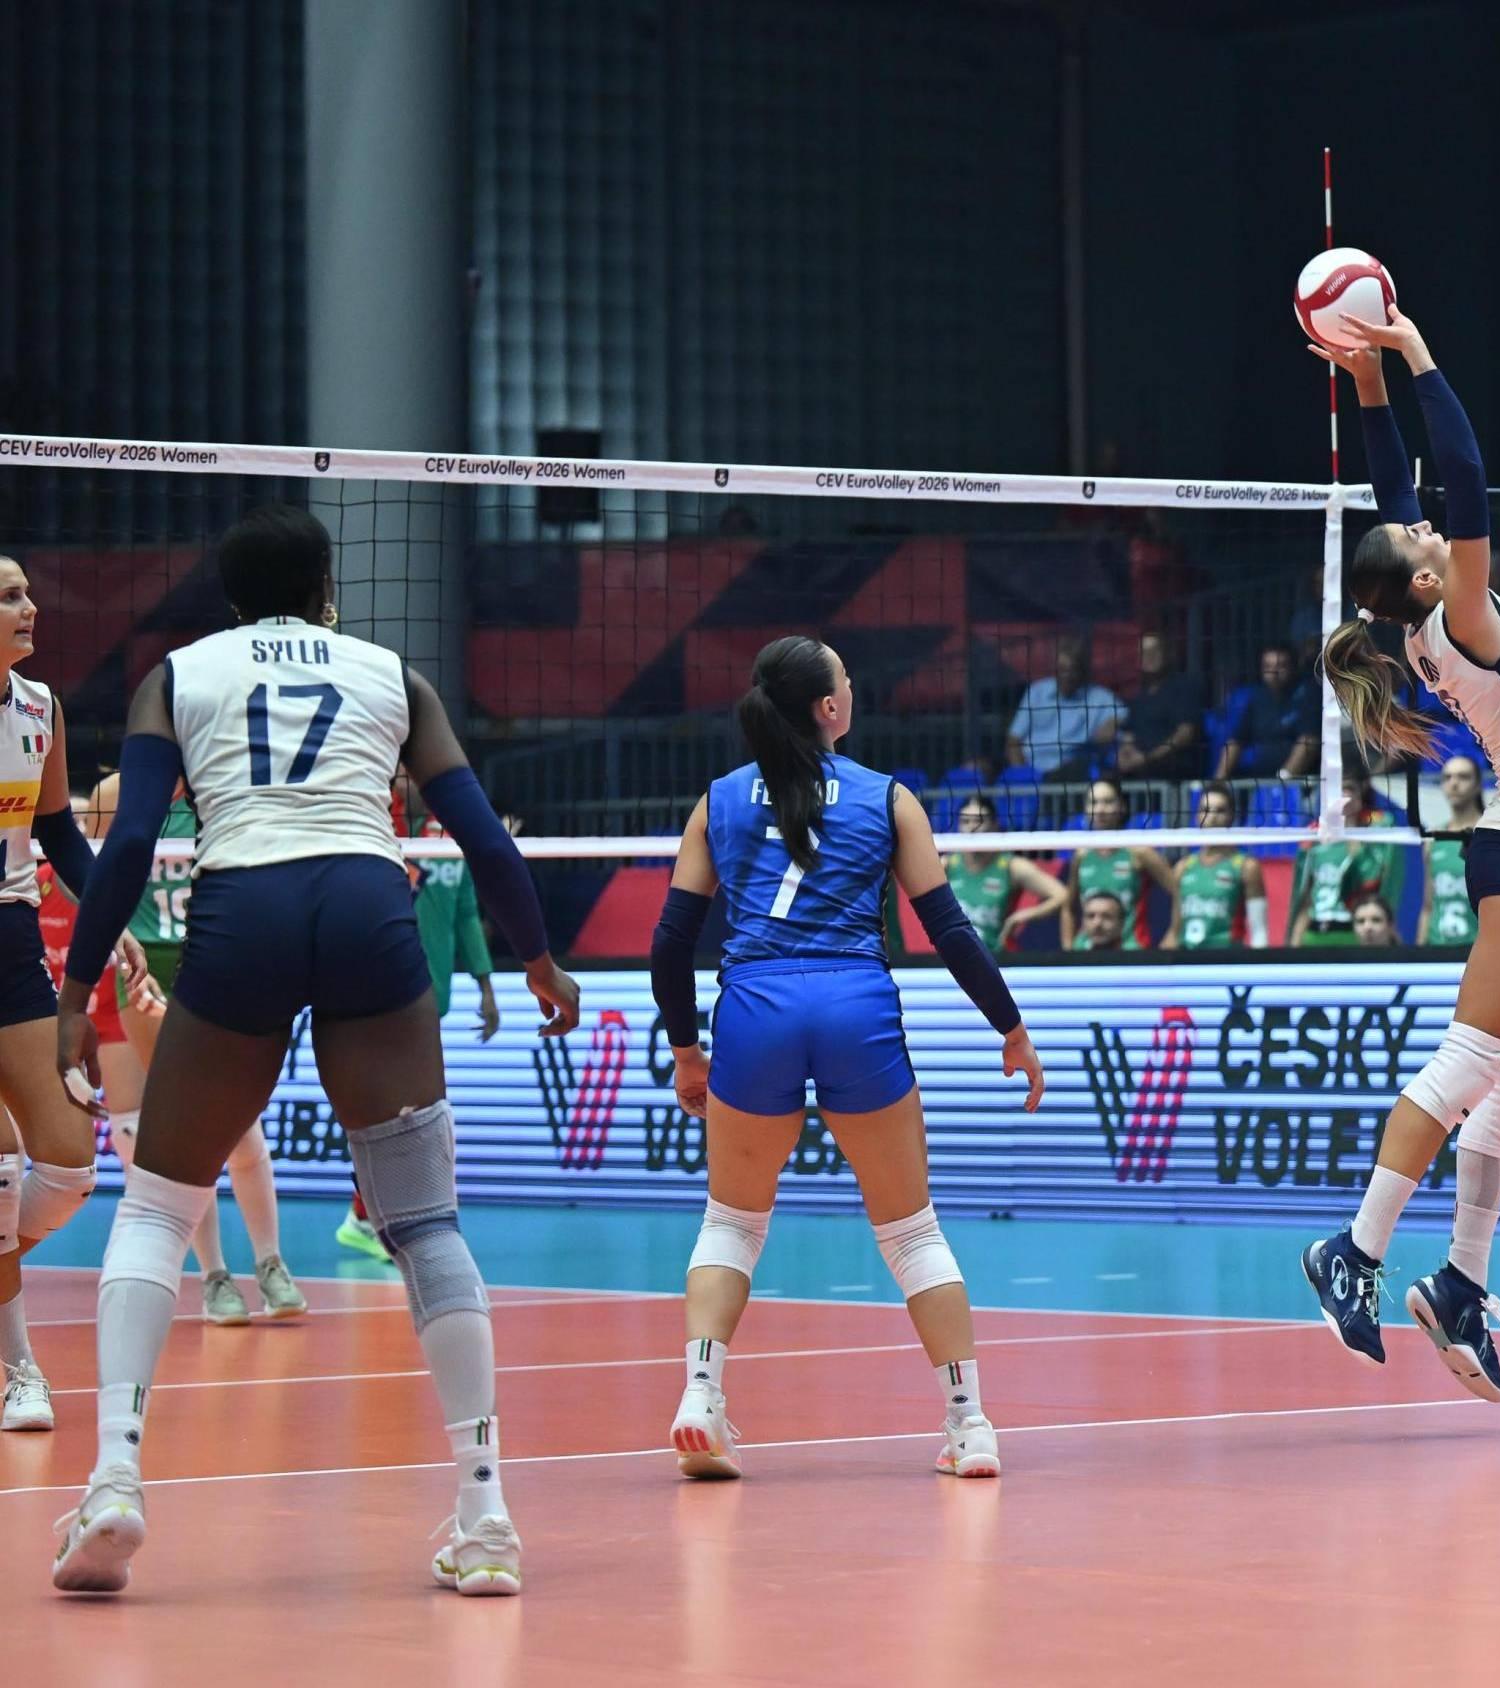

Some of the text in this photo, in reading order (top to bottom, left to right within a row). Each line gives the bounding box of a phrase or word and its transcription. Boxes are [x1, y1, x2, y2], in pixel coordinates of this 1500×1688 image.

[0, 439, 217, 464] CEV EuroVolley 2026 Women
[425, 457, 625, 480] CEV EuroVolley 2026 Women
[816, 473, 1000, 493] CEV EuroVolley 2026 Women
[1176, 485, 1200, 498] CEV
[1204, 486, 1267, 503] EuroVolley
[1270, 488, 1298, 501] 2026
[252, 640, 329, 664] SYLLA
[247, 683, 343, 786] 17
[766, 826, 820, 919] 7
[1219, 985, 1418, 1089] ČESKÝ
